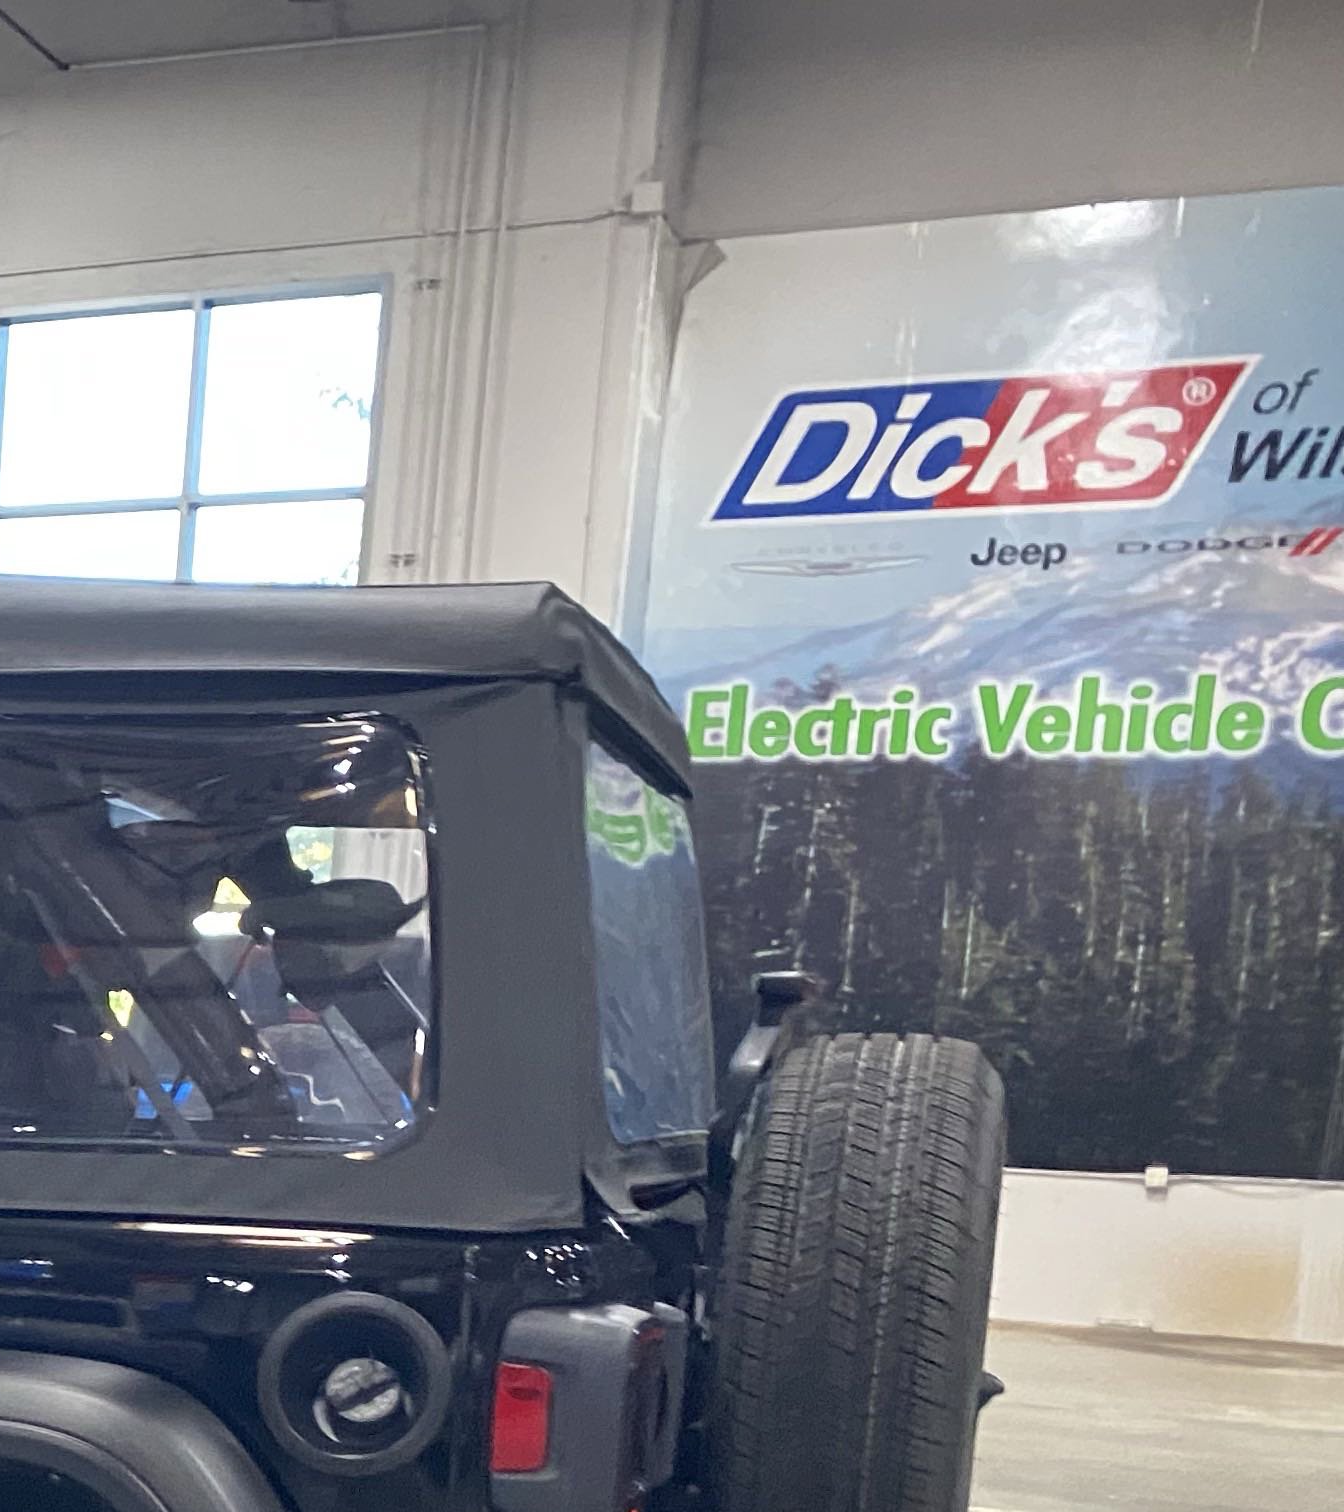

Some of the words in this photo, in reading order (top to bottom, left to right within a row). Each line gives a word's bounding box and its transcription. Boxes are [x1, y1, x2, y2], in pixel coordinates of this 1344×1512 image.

[1253, 368, 1321, 415] of
[1228, 426, 1344, 483] Wil
[970, 537, 1068, 570] Jeep
[687, 684, 952, 758] Electric
[979, 674, 1265, 754] Vehicle
